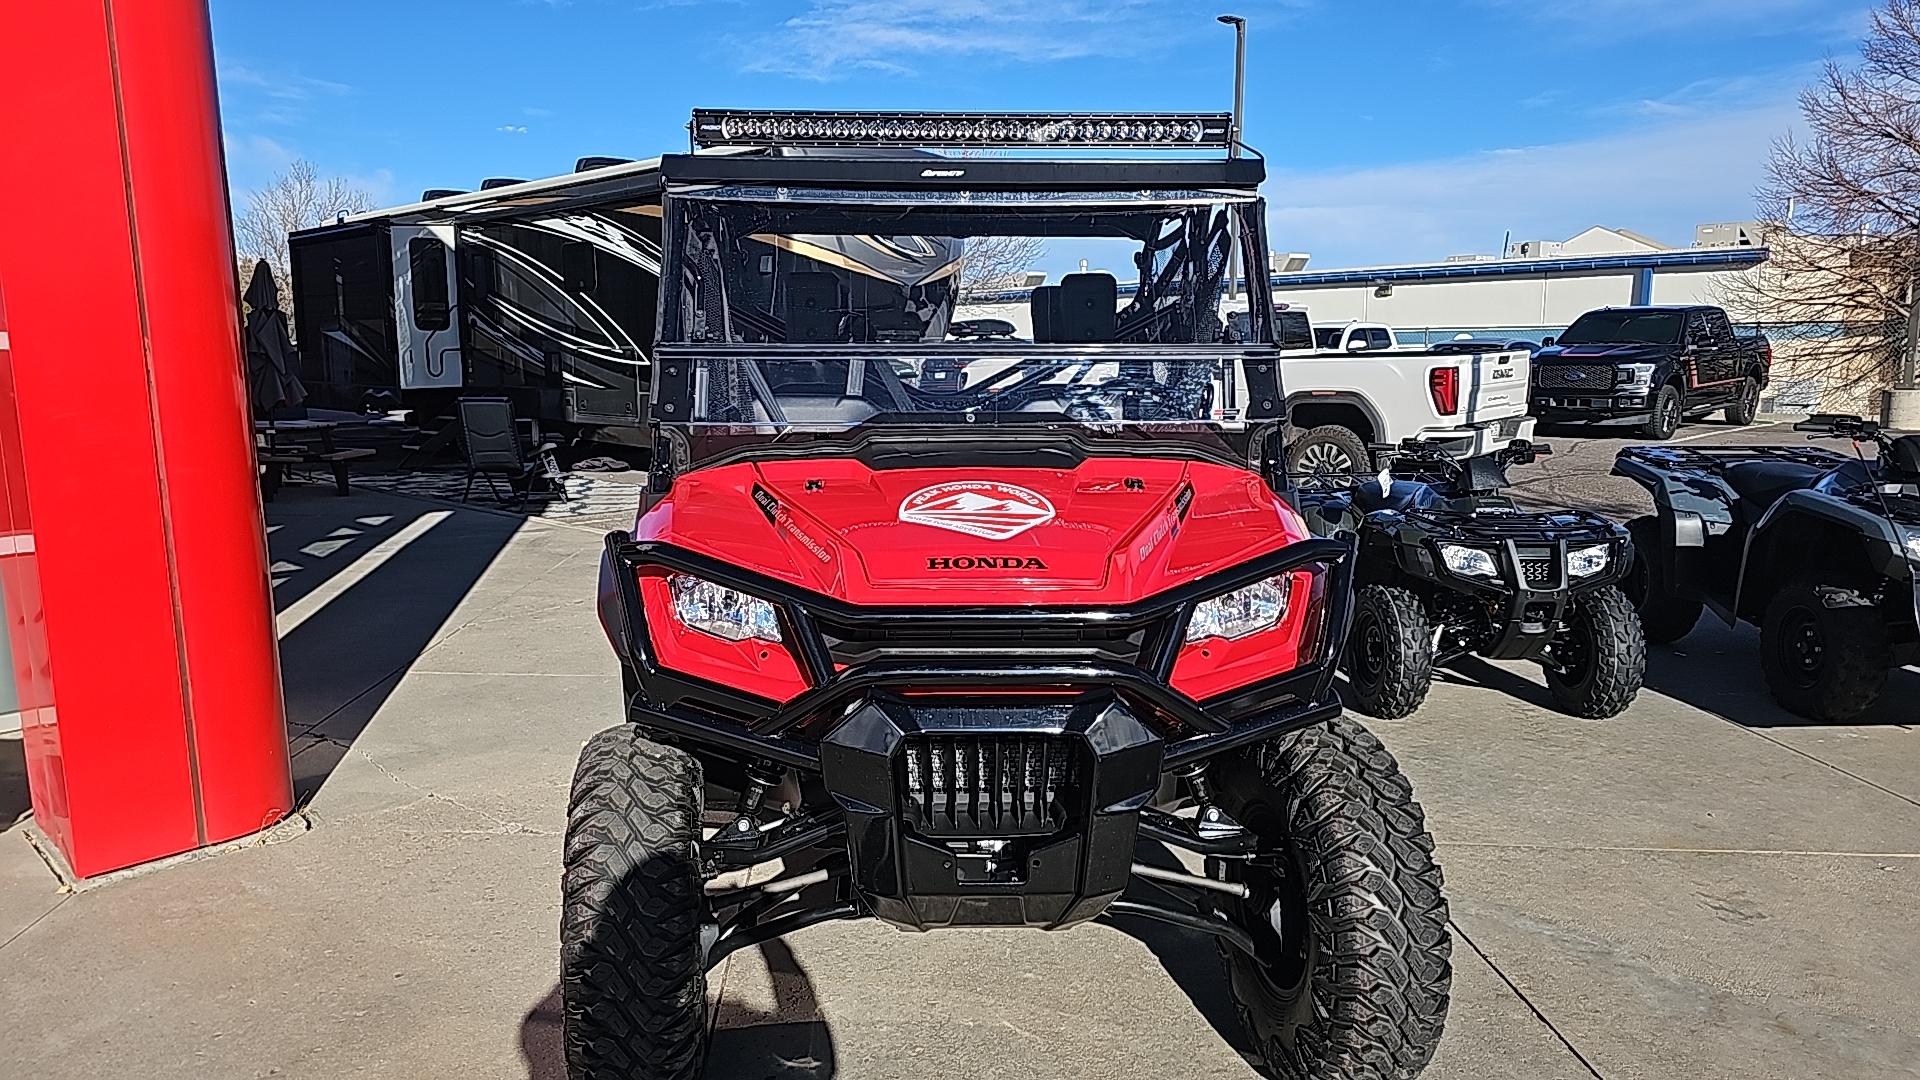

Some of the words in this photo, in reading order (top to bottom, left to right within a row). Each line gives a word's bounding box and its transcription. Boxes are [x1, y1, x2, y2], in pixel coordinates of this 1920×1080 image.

[912, 488, 943, 505] PEAK
[941, 484, 993, 493] HONDA
[997, 485, 1040, 505] WORLD
[754, 490, 772, 507] Dual
[766, 501, 788, 524] Clutch
[783, 517, 832, 563] Transmission
[926, 556, 1049, 570] HONDA
